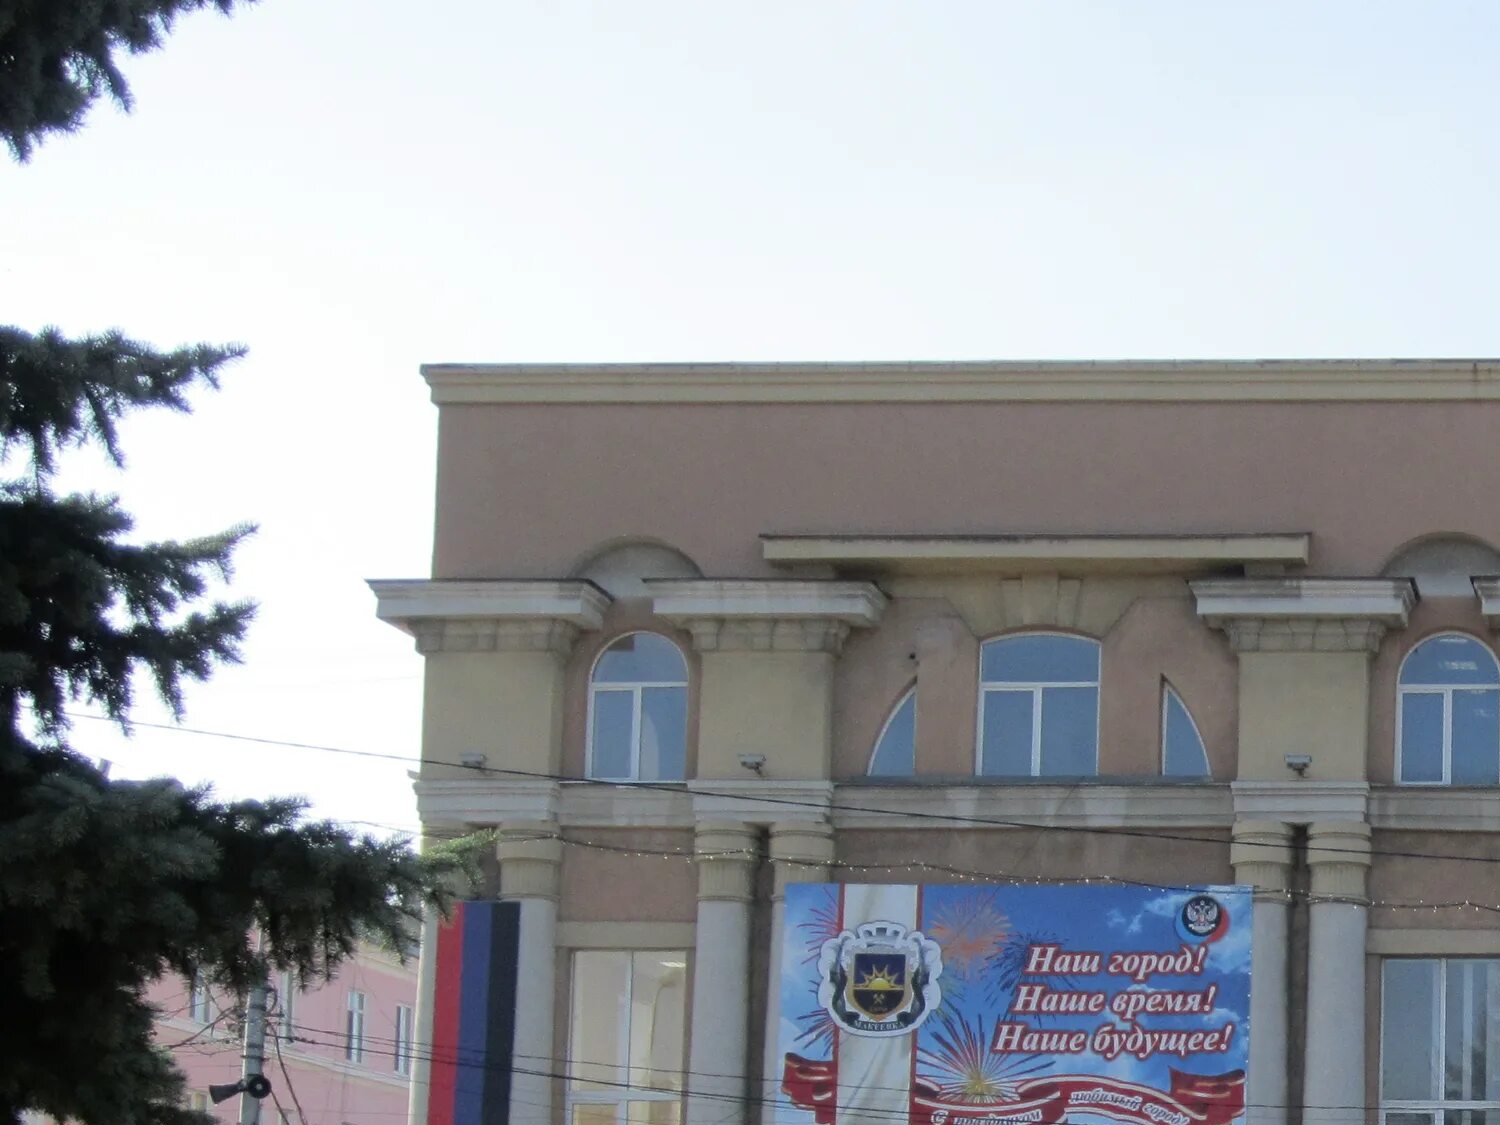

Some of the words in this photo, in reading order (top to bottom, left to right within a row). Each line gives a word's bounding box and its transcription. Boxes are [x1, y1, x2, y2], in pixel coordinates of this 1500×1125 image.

[1025, 946, 1100, 973] Наш
[1108, 945, 1206, 980] город!
[1013, 985, 1105, 1012] Наше
[1112, 986, 1216, 1019] время!
[993, 1024, 1088, 1051] Наше
[1093, 1025, 1233, 1058] будущее!
[932, 1110, 948, 1125] С
